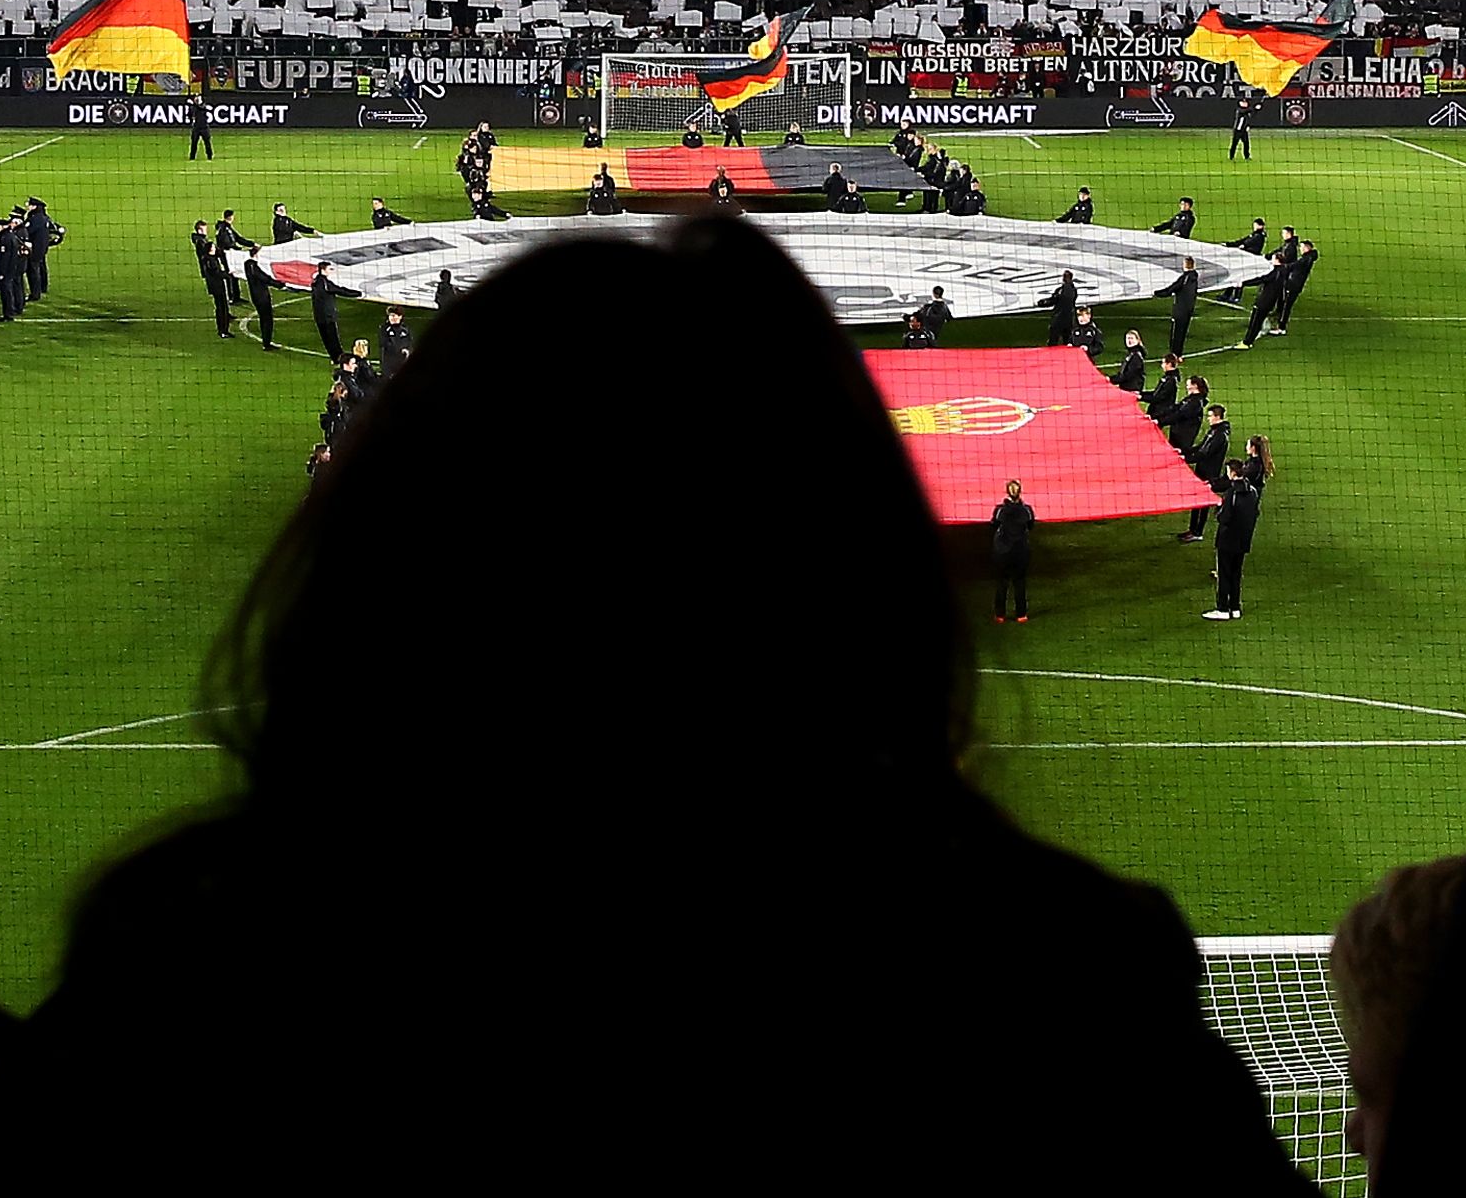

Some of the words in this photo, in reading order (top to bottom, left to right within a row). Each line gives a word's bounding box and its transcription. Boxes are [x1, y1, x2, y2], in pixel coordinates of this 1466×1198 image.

[1072, 37, 1189, 57] HARZBUR
[788, 60, 906, 84] TEMPLIN
[911, 58, 973, 73] ADLER
[984, 56, 1068, 73] BRETTEN
[69, 105, 105, 124] DIE
[817, 105, 852, 123] DIE
[881, 105, 1037, 124] MANNSCHAFT
